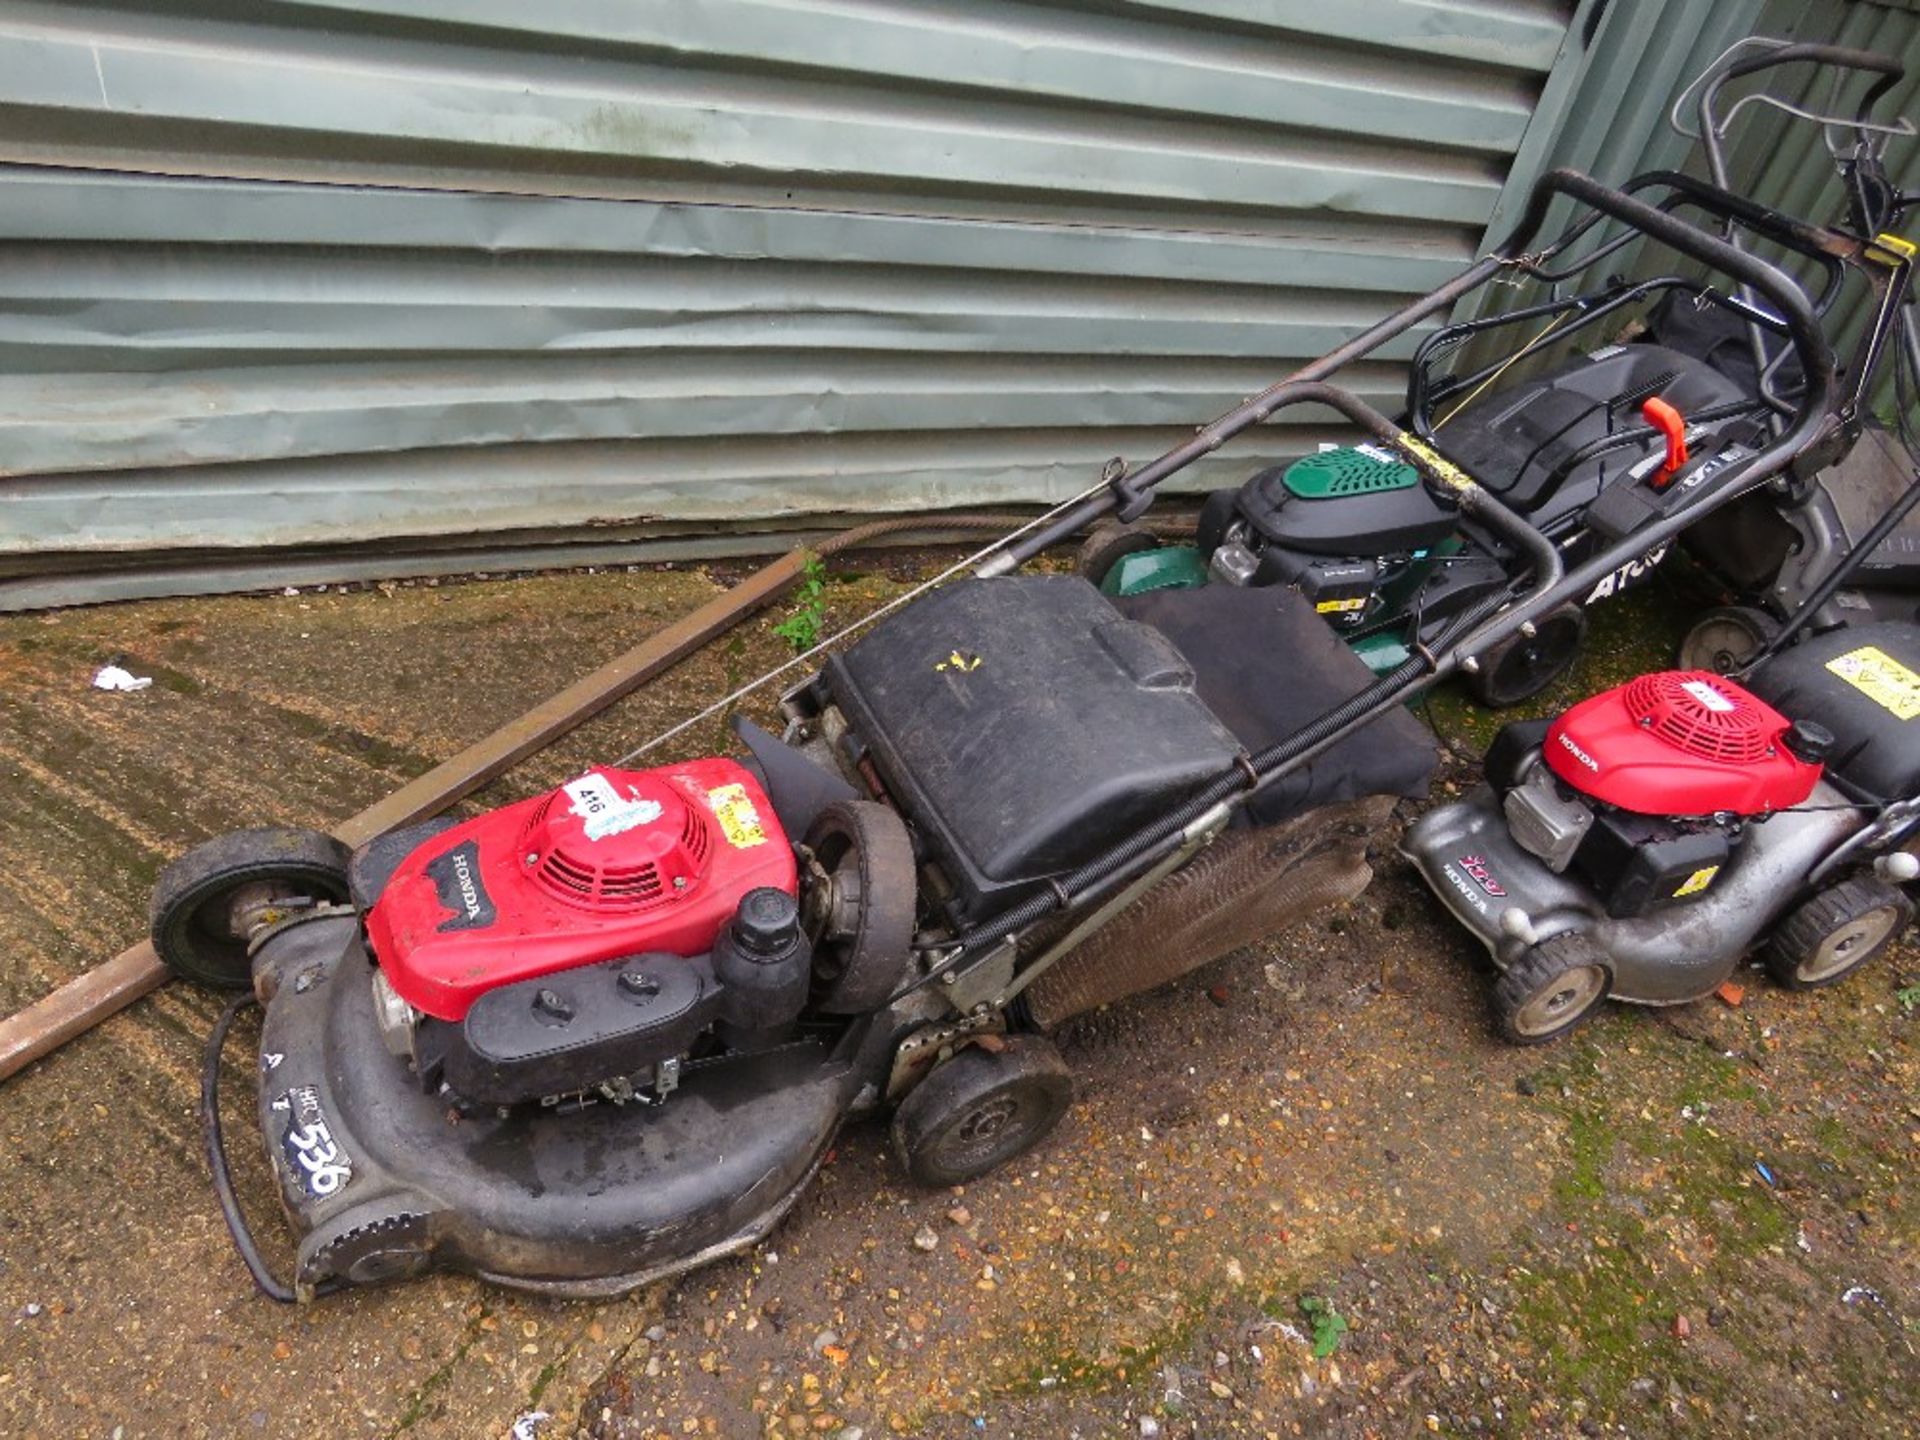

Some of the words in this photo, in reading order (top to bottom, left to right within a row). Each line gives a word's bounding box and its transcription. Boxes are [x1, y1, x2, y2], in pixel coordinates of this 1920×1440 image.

[1558, 733, 1599, 773] HONDA
[580, 790, 606, 813] 416
[453, 854, 481, 920] HONDA
[1443, 863, 1487, 914] HONDA
[289, 1120, 352, 1194] 536
